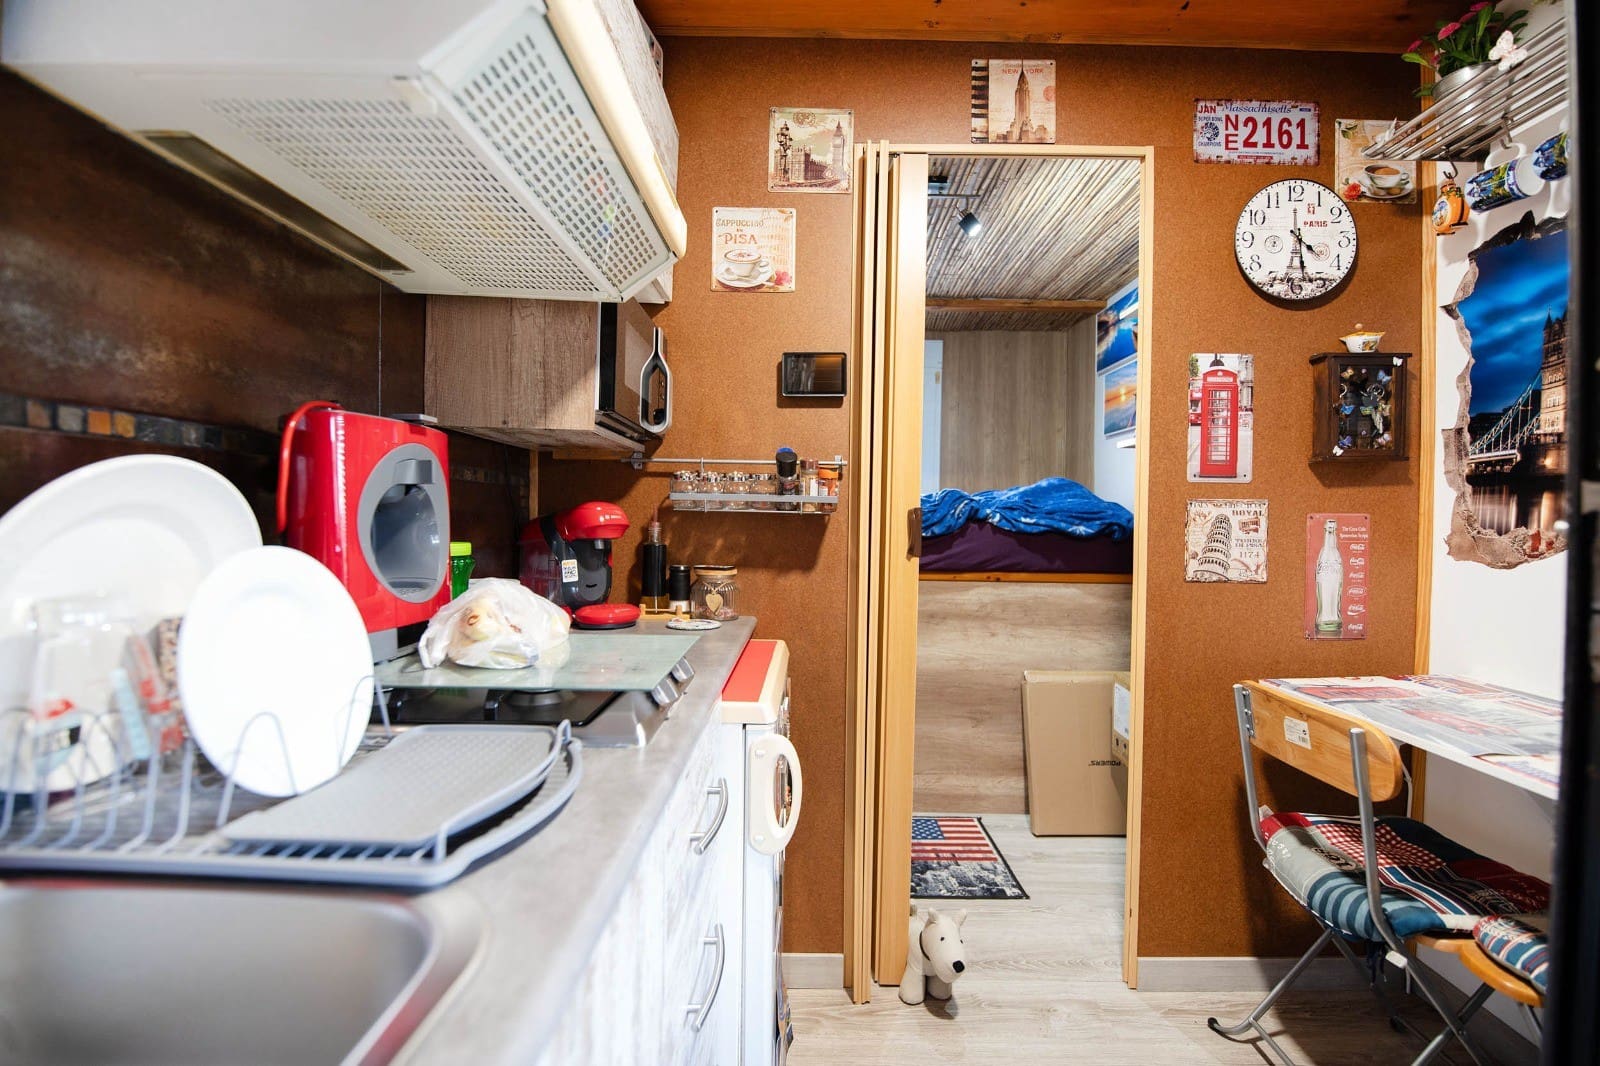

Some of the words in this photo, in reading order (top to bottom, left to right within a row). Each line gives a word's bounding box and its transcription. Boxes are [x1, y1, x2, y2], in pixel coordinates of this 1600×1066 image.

[1198, 104, 1217, 114] JAN
[1222, 102, 1292, 114] Massachusetts
[1242, 116, 1310, 150] 2161
[1266, 191, 1280, 209] 11
[1287, 184, 1305, 202] 12
[1316, 190, 1322, 207] 1
[1249, 209, 1266, 226] 10
[1303, 220, 1328, 228] PARIS
[1329, 206, 1342, 224] 2
[719, 232, 758, 245] PISA
[1241, 231, 1255, 249] 9
[1337, 230, 1351, 248] 3
[1249, 254, 1262, 272] 8
[1329, 253, 1342, 271] 4
[1239, 551, 1260, 559] 1174
